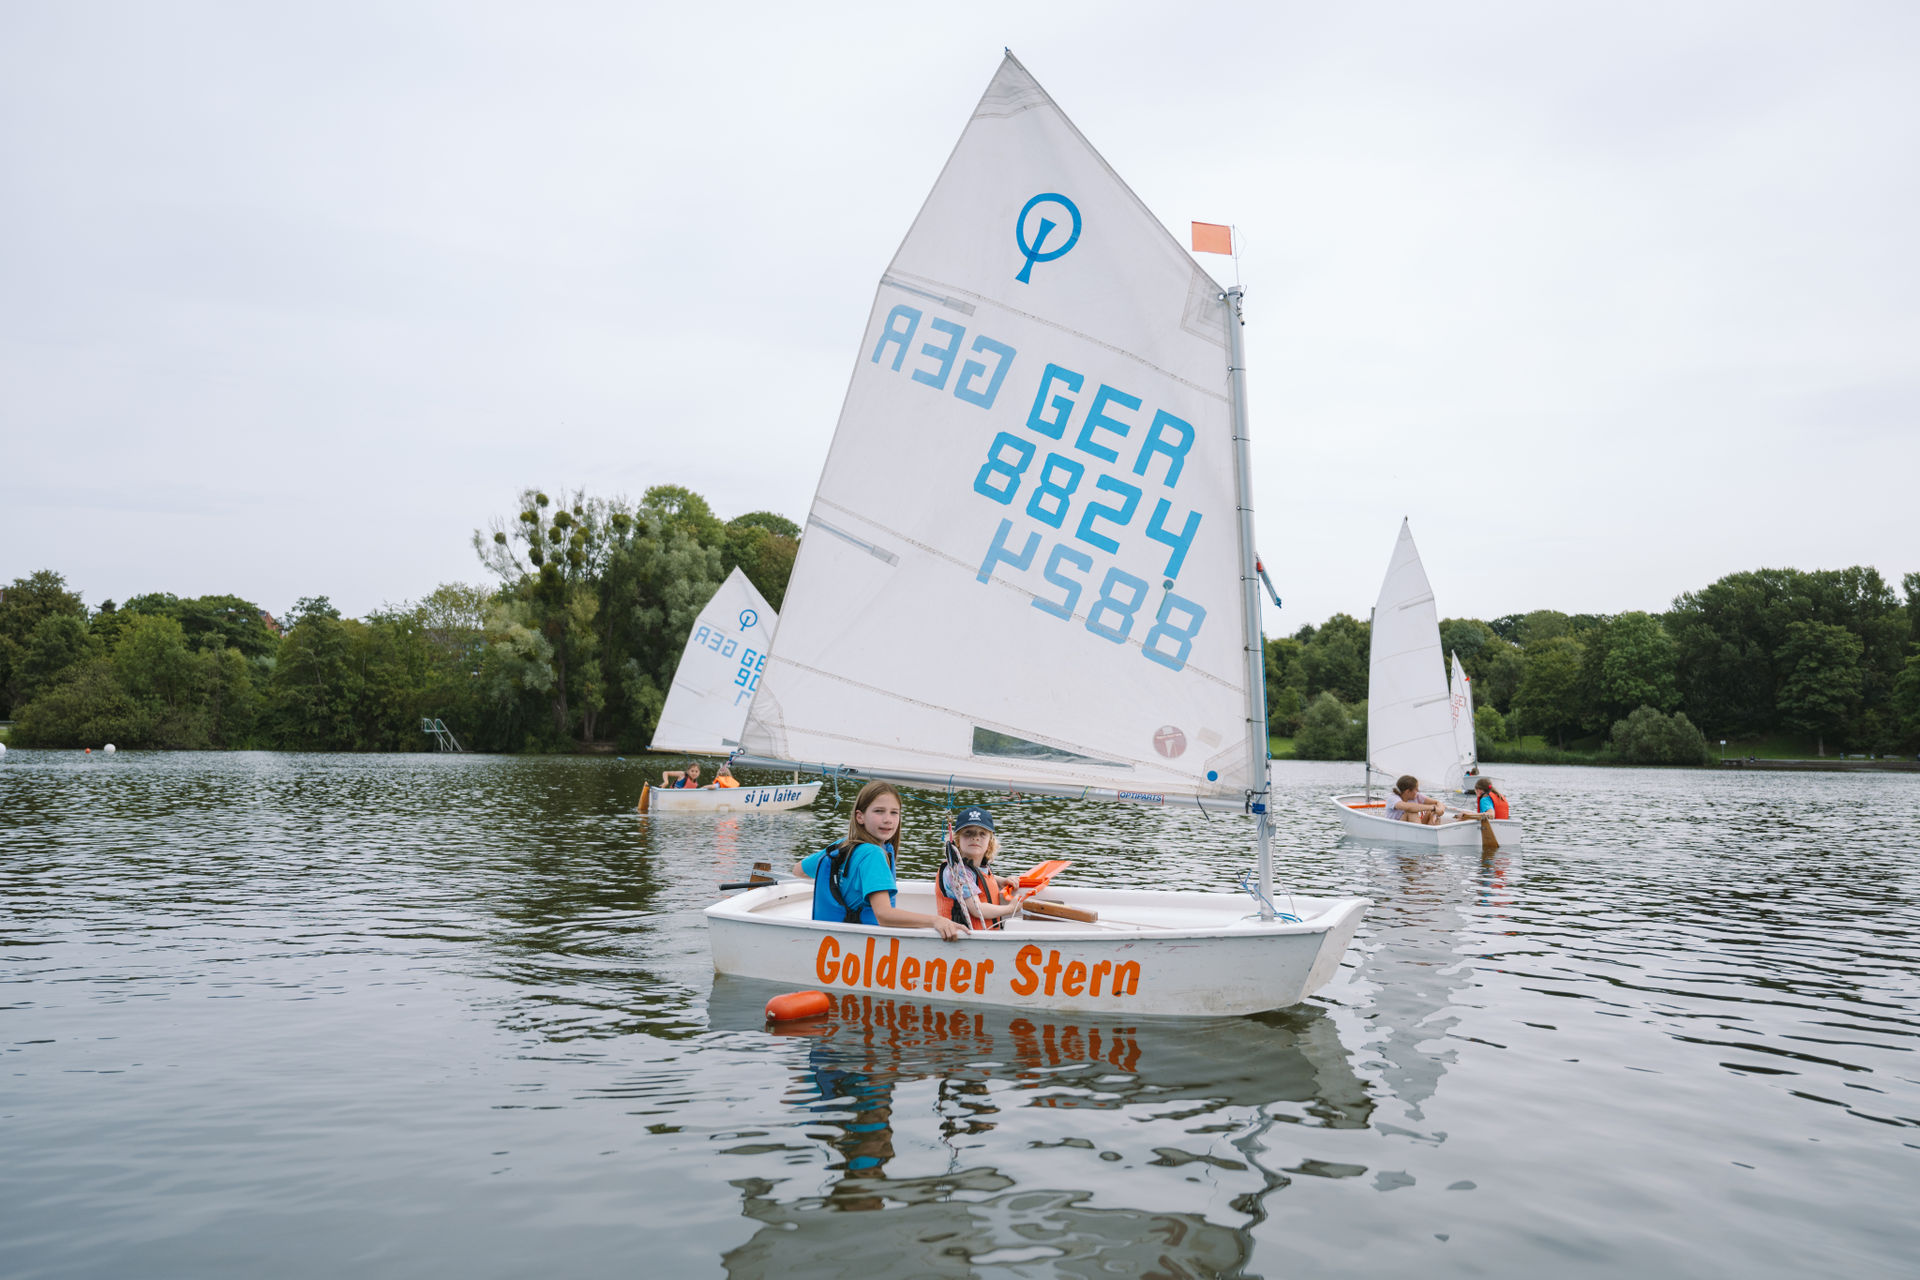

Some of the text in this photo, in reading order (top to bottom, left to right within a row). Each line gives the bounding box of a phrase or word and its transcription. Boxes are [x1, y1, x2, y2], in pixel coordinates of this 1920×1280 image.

[1025, 362, 1196, 489] GER
[973, 431, 1204, 581] 8824
[741, 647, 766, 673] GE
[744, 788, 802, 807] si ju laiter
[1119, 791, 1162, 802] OPTIPARTS
[816, 935, 1141, 998] Goldener Stern
